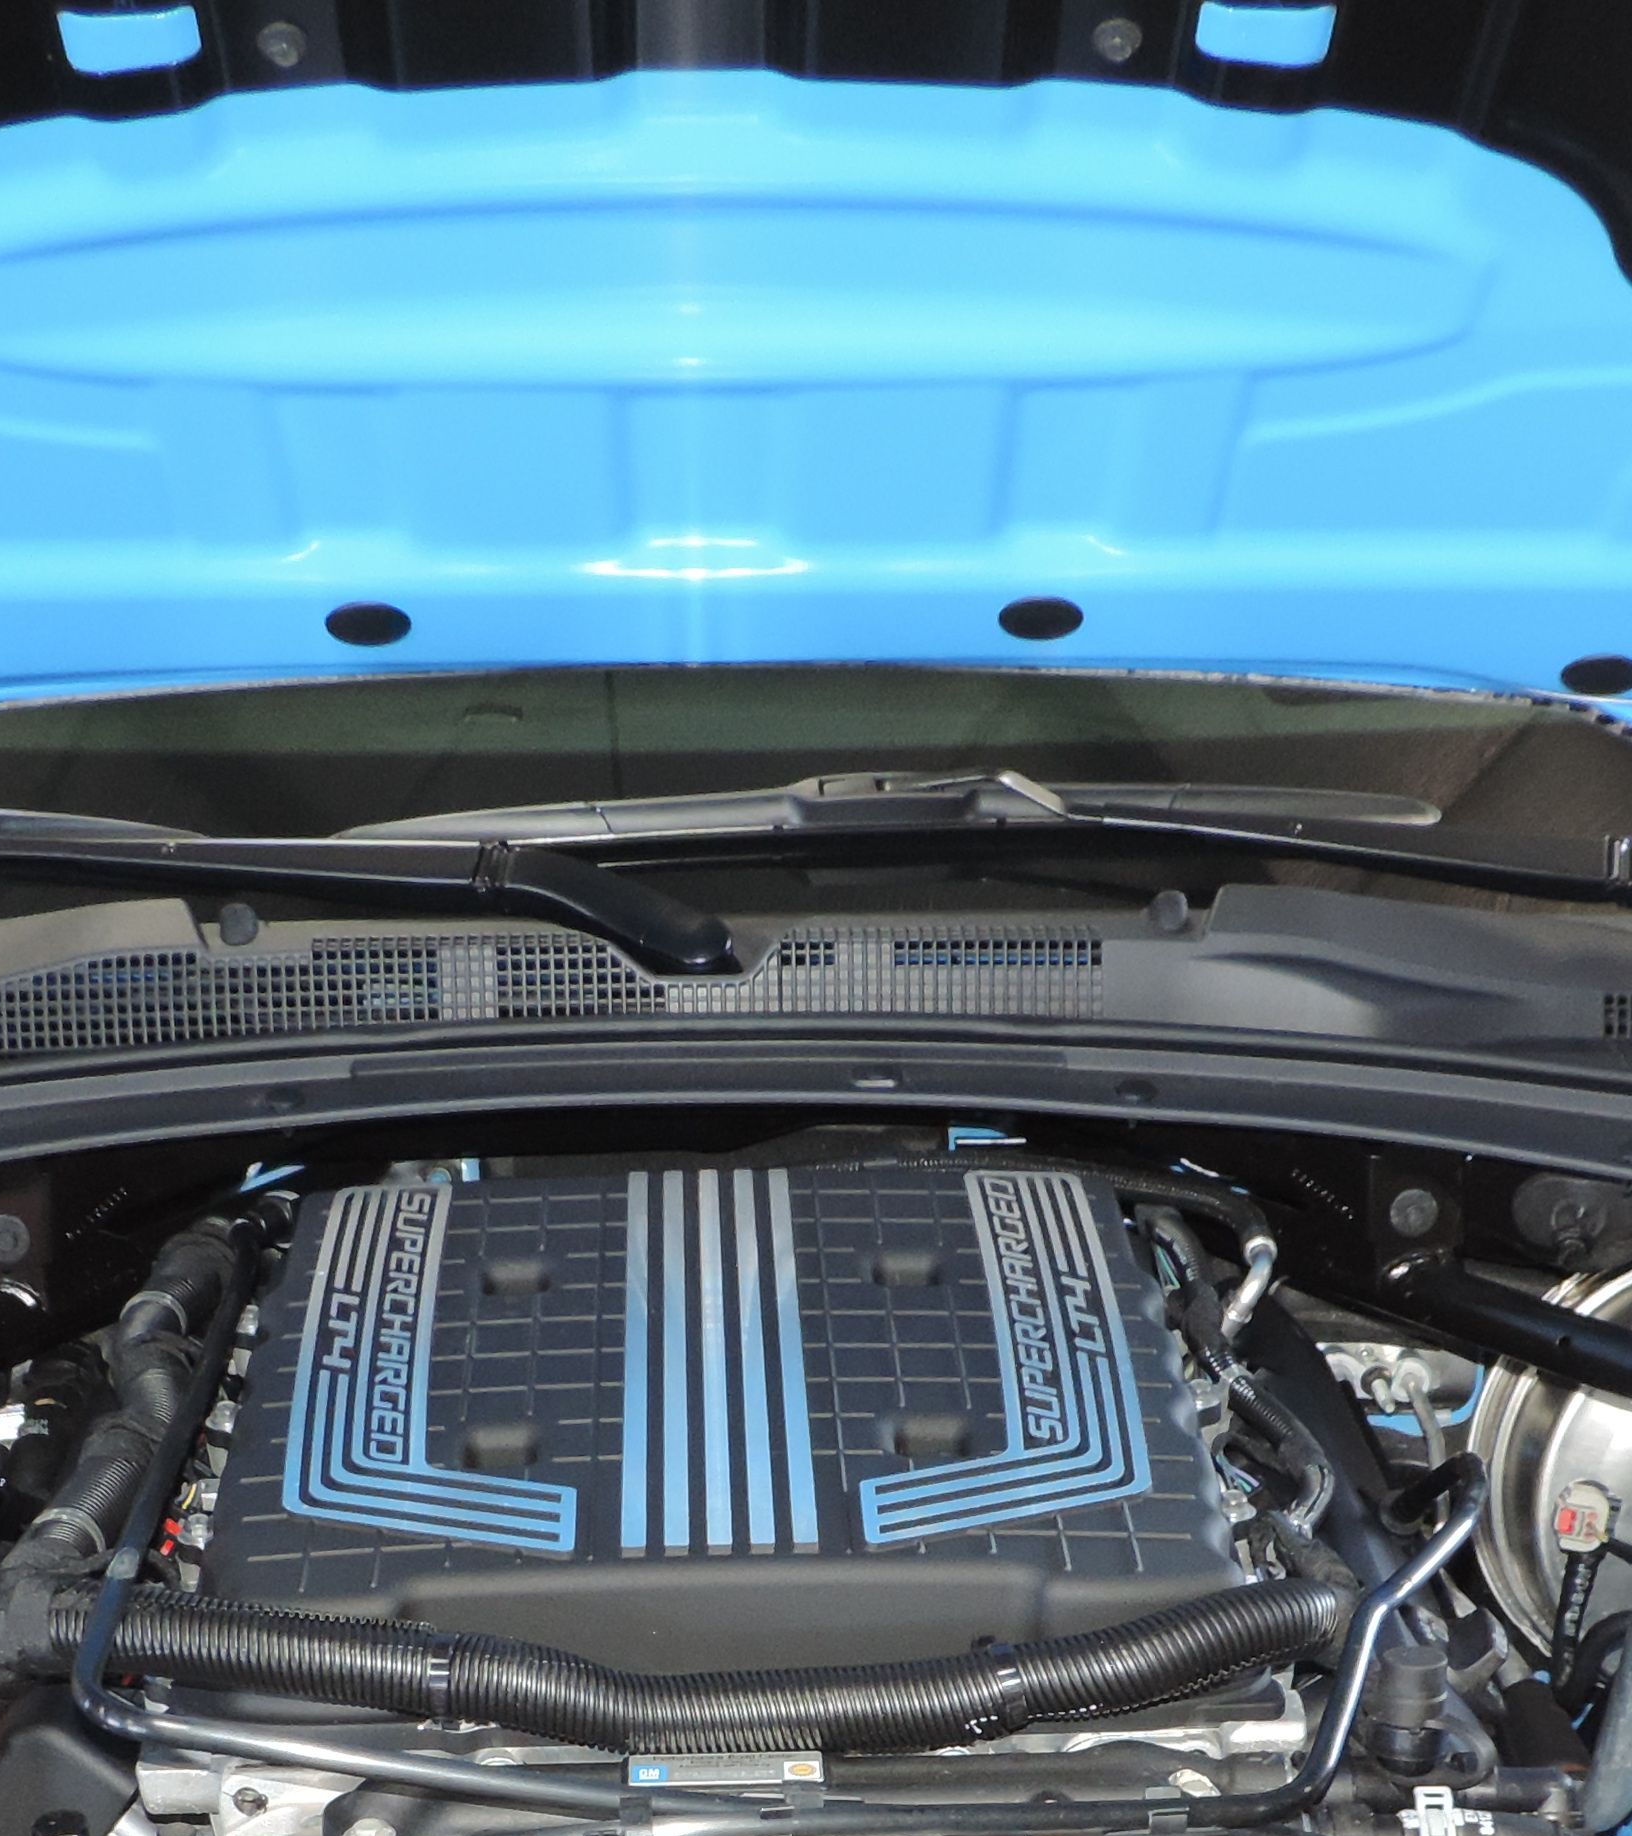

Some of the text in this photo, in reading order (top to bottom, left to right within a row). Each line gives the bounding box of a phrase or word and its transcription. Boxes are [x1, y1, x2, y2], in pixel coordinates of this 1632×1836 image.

[322, 1292, 361, 1370] LT4
[368, 1190, 432, 1464] SUPERCHARGED
[982, 1176, 1064, 1442] SUPERCHARGED
[1060, 1274, 1107, 1355] LT4
[638, 1767, 660, 1780] GM
